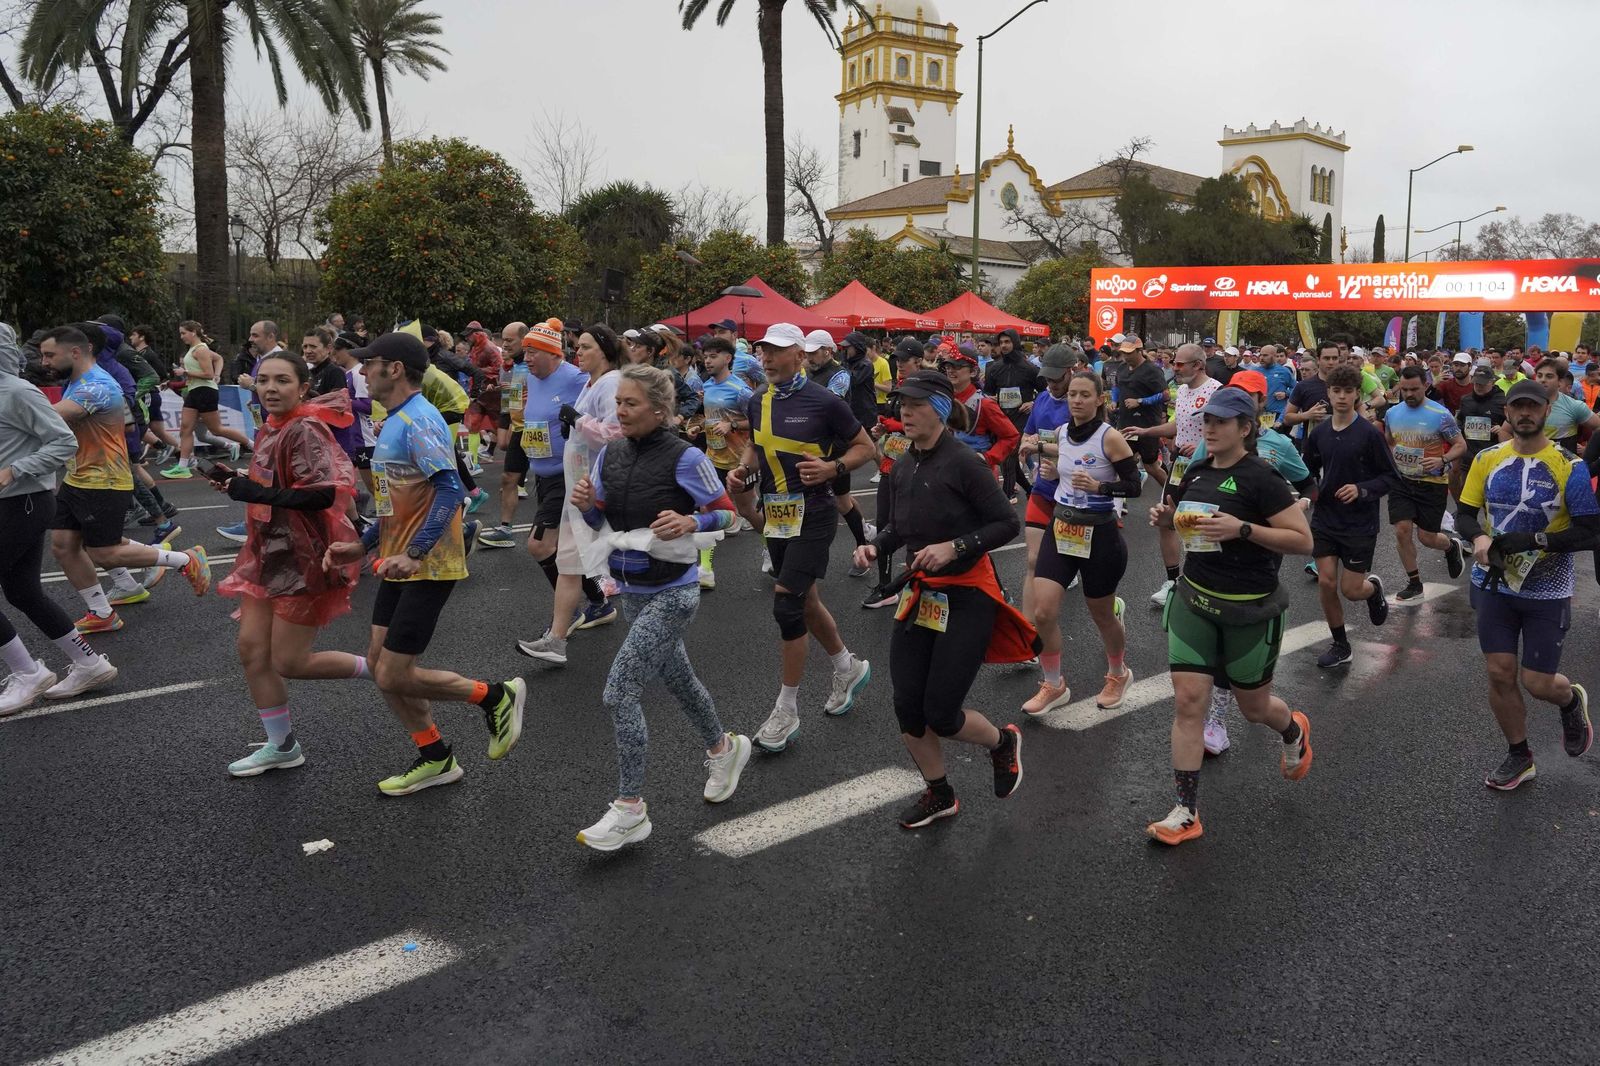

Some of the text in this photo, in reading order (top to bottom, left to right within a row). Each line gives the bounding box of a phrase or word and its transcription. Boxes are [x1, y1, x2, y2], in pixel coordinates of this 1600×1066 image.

[1356, 272, 1429, 287] maratón
[1445, 281, 1505, 293] 00:11:04
[1520, 275, 1580, 293] HOKA
[1170, 283, 1207, 293] Sprinter
[1246, 280, 1290, 295] HOKA
[1373, 281, 1428, 299] sevilla
[1395, 451, 1418, 463] 22157
[767, 504, 797, 519] 15547
